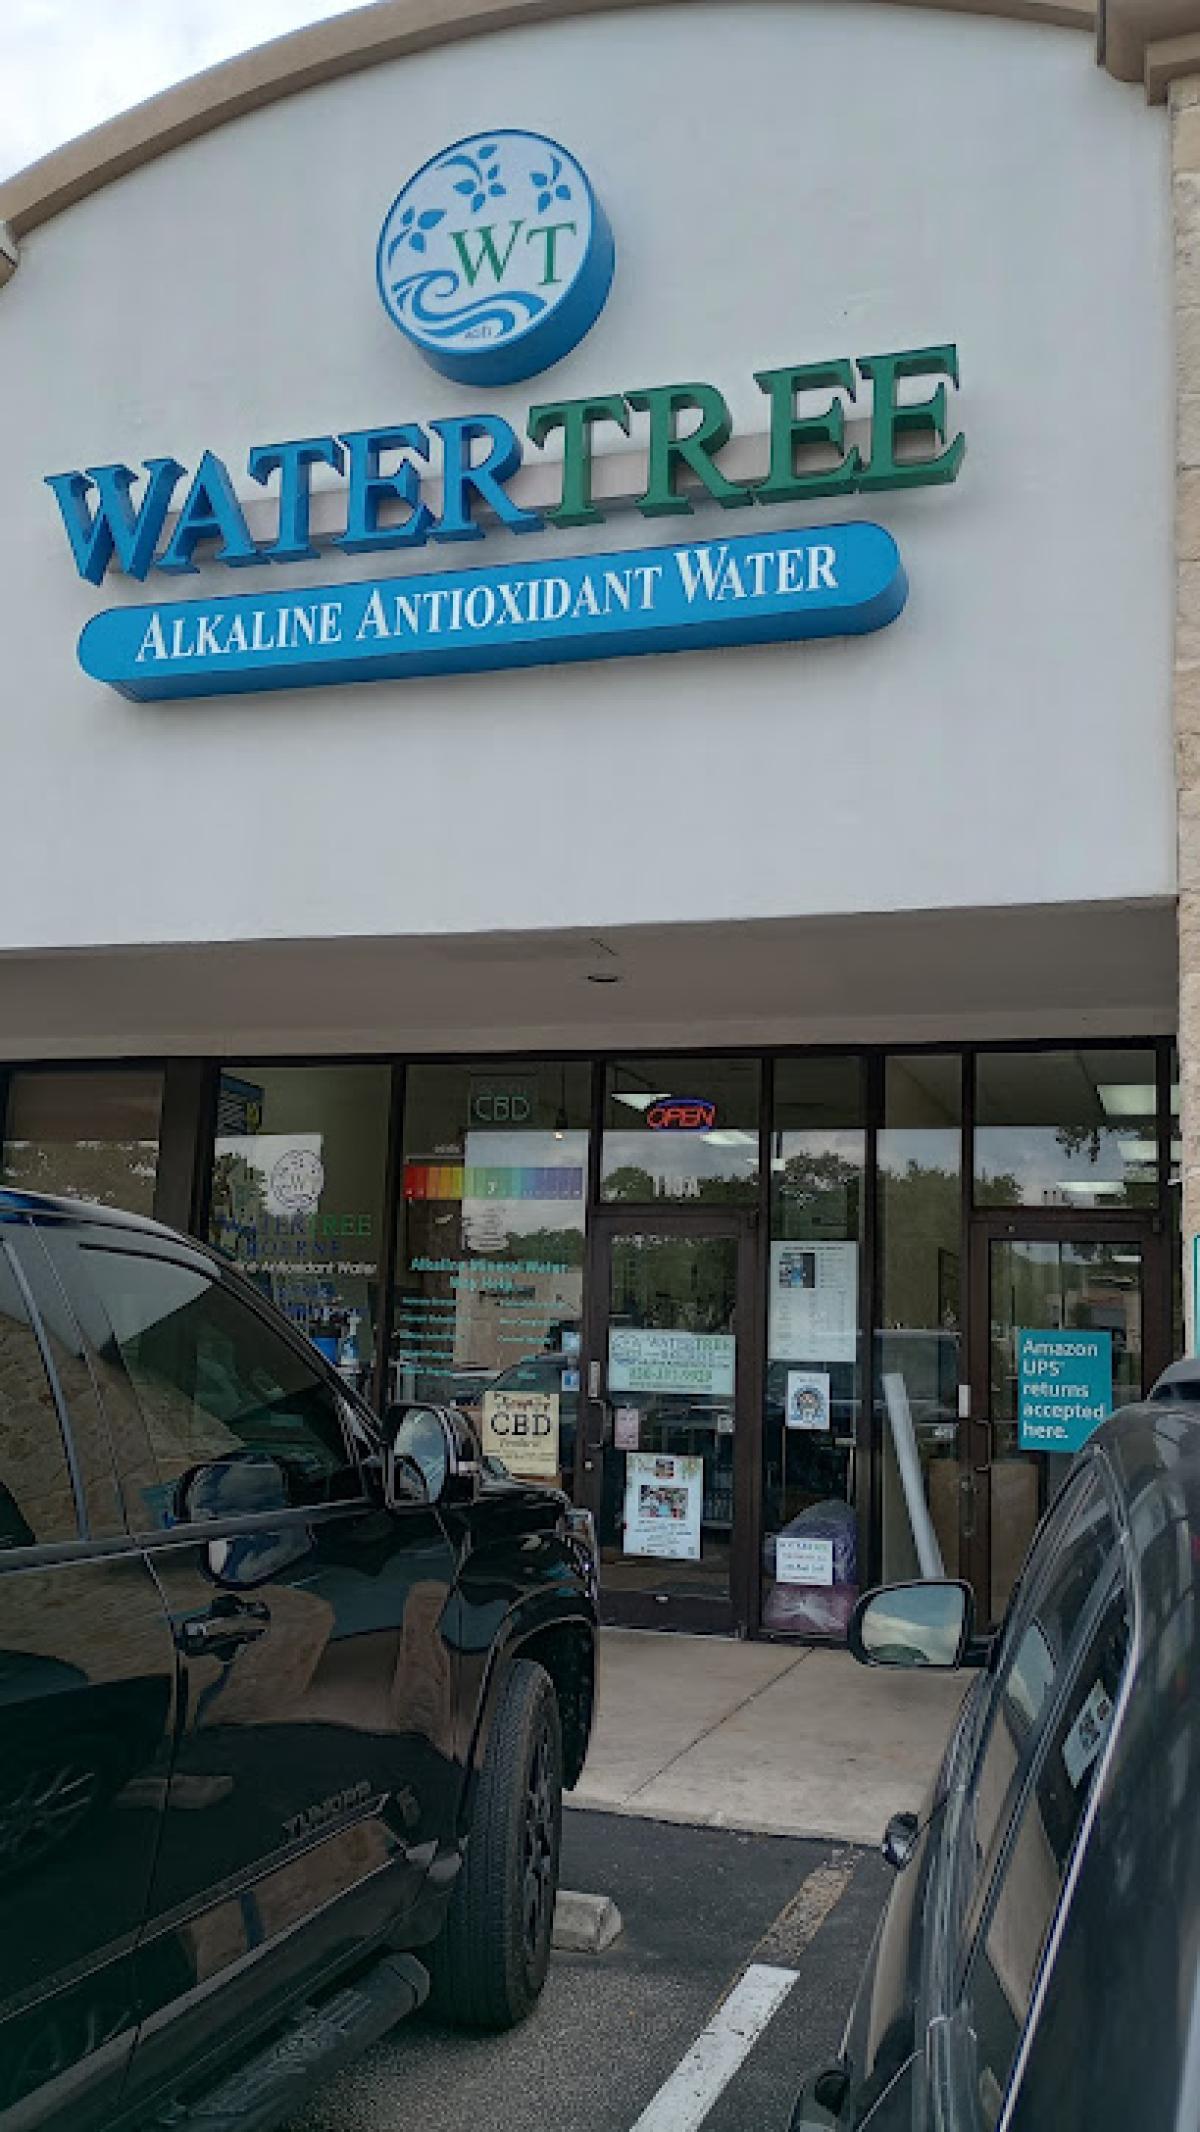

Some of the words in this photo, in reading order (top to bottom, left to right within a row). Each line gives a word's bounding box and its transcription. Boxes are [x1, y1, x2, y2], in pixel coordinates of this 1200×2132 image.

[450, 218, 577, 288] WT
[44, 343, 967, 588] WATERTREE
[136, 601, 343, 663] ALKALINE
[356, 566, 663, 641] ANTIOXIDANT
[677, 544, 839, 604] WATER
[475, 1096, 531, 1121] CBD
[647, 1104, 717, 1128] OPEN
[1022, 1338, 1099, 1357] Amazon
[1022, 1381, 1090, 1398] returns
[490, 1411, 552, 1436] CBD
[1022, 1402, 1105, 1422] accepted
[1022, 1420, 1069, 1439] here.
